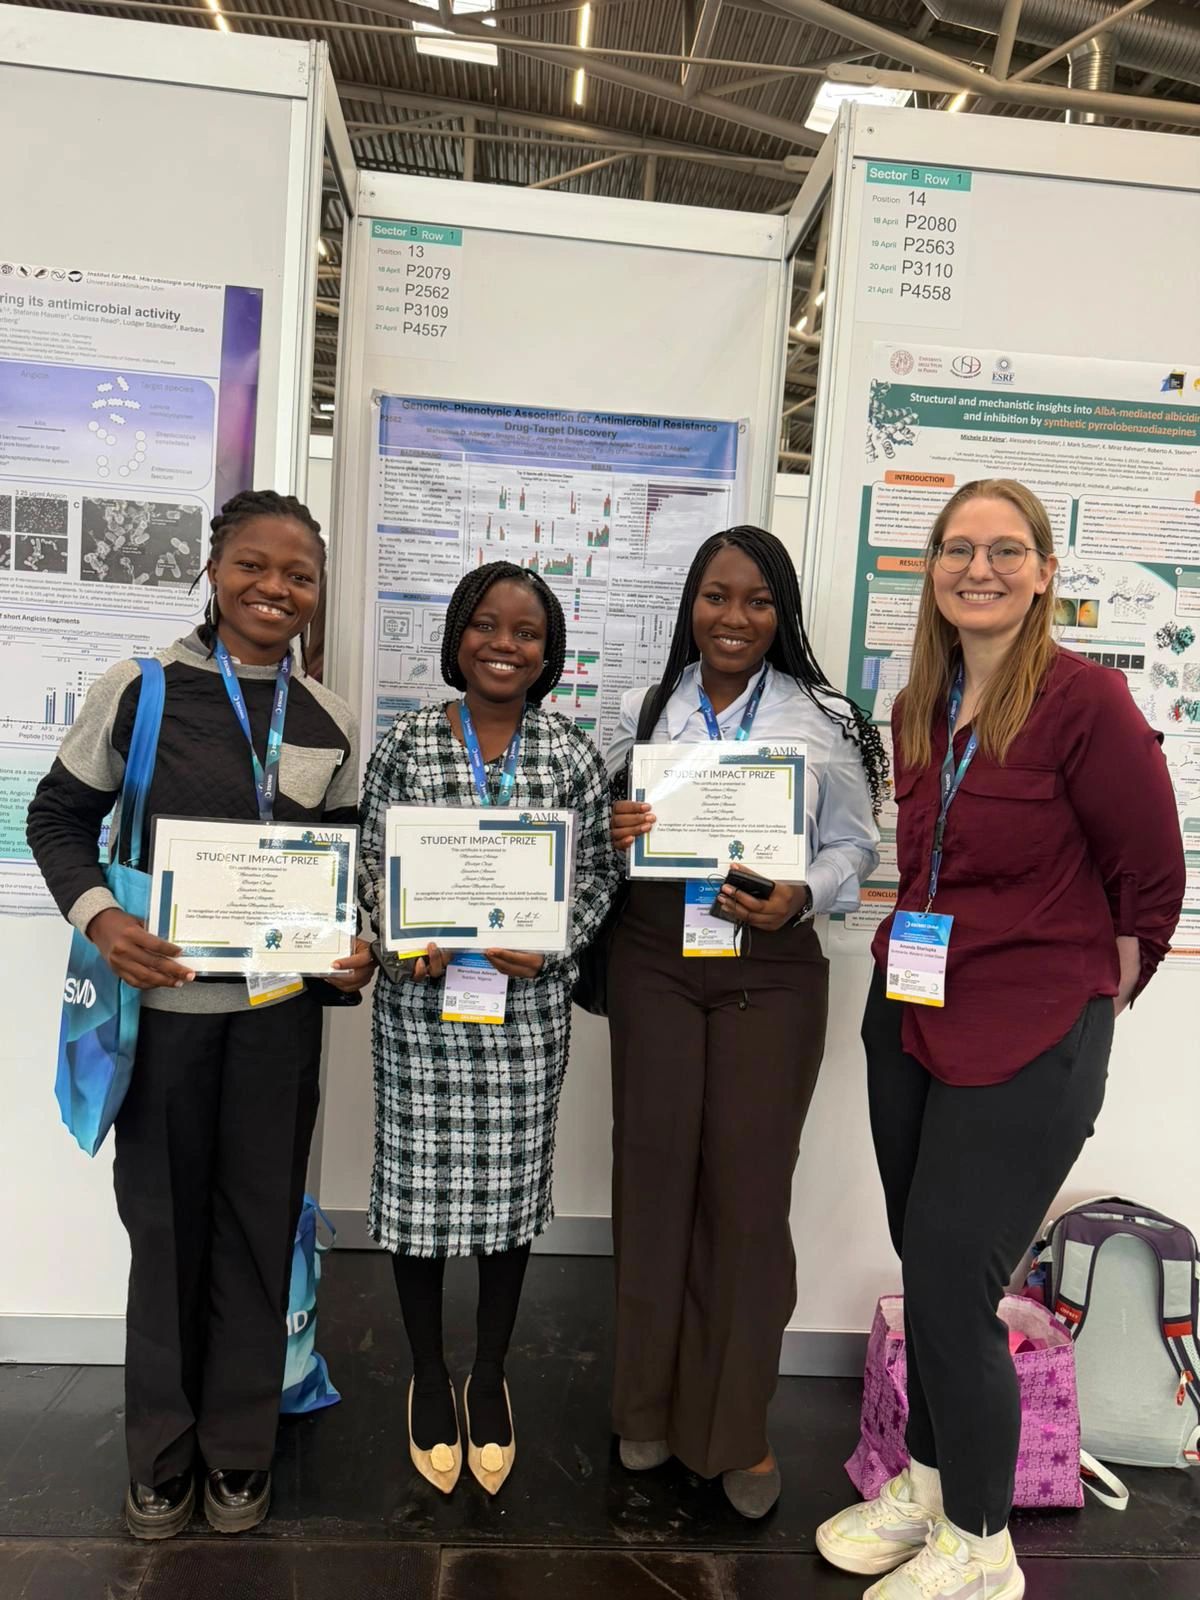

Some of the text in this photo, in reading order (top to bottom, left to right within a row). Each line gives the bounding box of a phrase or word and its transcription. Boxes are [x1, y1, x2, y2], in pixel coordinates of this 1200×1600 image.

[869, 167, 962, 185] Sector B Row 1
[872, 191, 926, 206] Position 14
[881, 217, 899, 226] April
[905, 214, 957, 232] P2080
[374, 225, 454, 241] Sector B Row 1
[377, 245, 424, 258] Position 13
[879, 240, 897, 249] April
[903, 237, 955, 256] P2563
[386, 266, 400, 275] April
[406, 264, 451, 280] P2079
[869, 259, 953, 278] 20 April P3110
[196, 282, 222, 291] Hygiene
[386, 286, 399, 294] April
[405, 283, 450, 299] P2562
[867, 282, 951, 301] 21 April P4558
[28, 295, 44, 307] its
[47, 298, 132, 316] antimicrobial
[135, 307, 181, 323] activity
[385, 305, 399, 313] April
[404, 302, 449, 319] P3109
[180, 325, 205, 334] Barbara
[383, 324, 397, 332] April
[403, 321, 447, 337] P4557
[910, 392, 957, 405] Structural
[958, 396, 977, 407] and
[978, 398, 1034, 411] mechanistic
[1036, 401, 1072, 414] insights
[1073, 404, 1093, 415] into
[1093, 405, 1164, 420] AlbA-mediated
[514, 408, 574, 422] Association
[576, 415, 591, 424] for
[593, 414, 661, 429] Antimicrobial
[663, 420, 718, 433] Resistance
[963, 411, 1197, 437] and inhibition by synthetic pyrrolobenzodiazepines
[504, 421, 565, 437] Drug-Target
[567, 426, 618, 441] Discovery
[1147, 447, 1167, 455] Roberto
[894, 474, 945, 483] INTRODUCTION
[22, 614, 46, 622] Angicin
[47, 616, 81, 625] fragments
[772, 747, 798, 755] AMR
[710, 770, 747, 779] IMPACT
[748, 770, 776, 779] PRIZE
[532, 812, 560, 822] AMR
[316, 832, 343, 842] AMR
[420, 836, 537, 846] STUDENT IMPACT PRIZE
[196, 851, 319, 865] STUDENT IMPACT PRIZE
